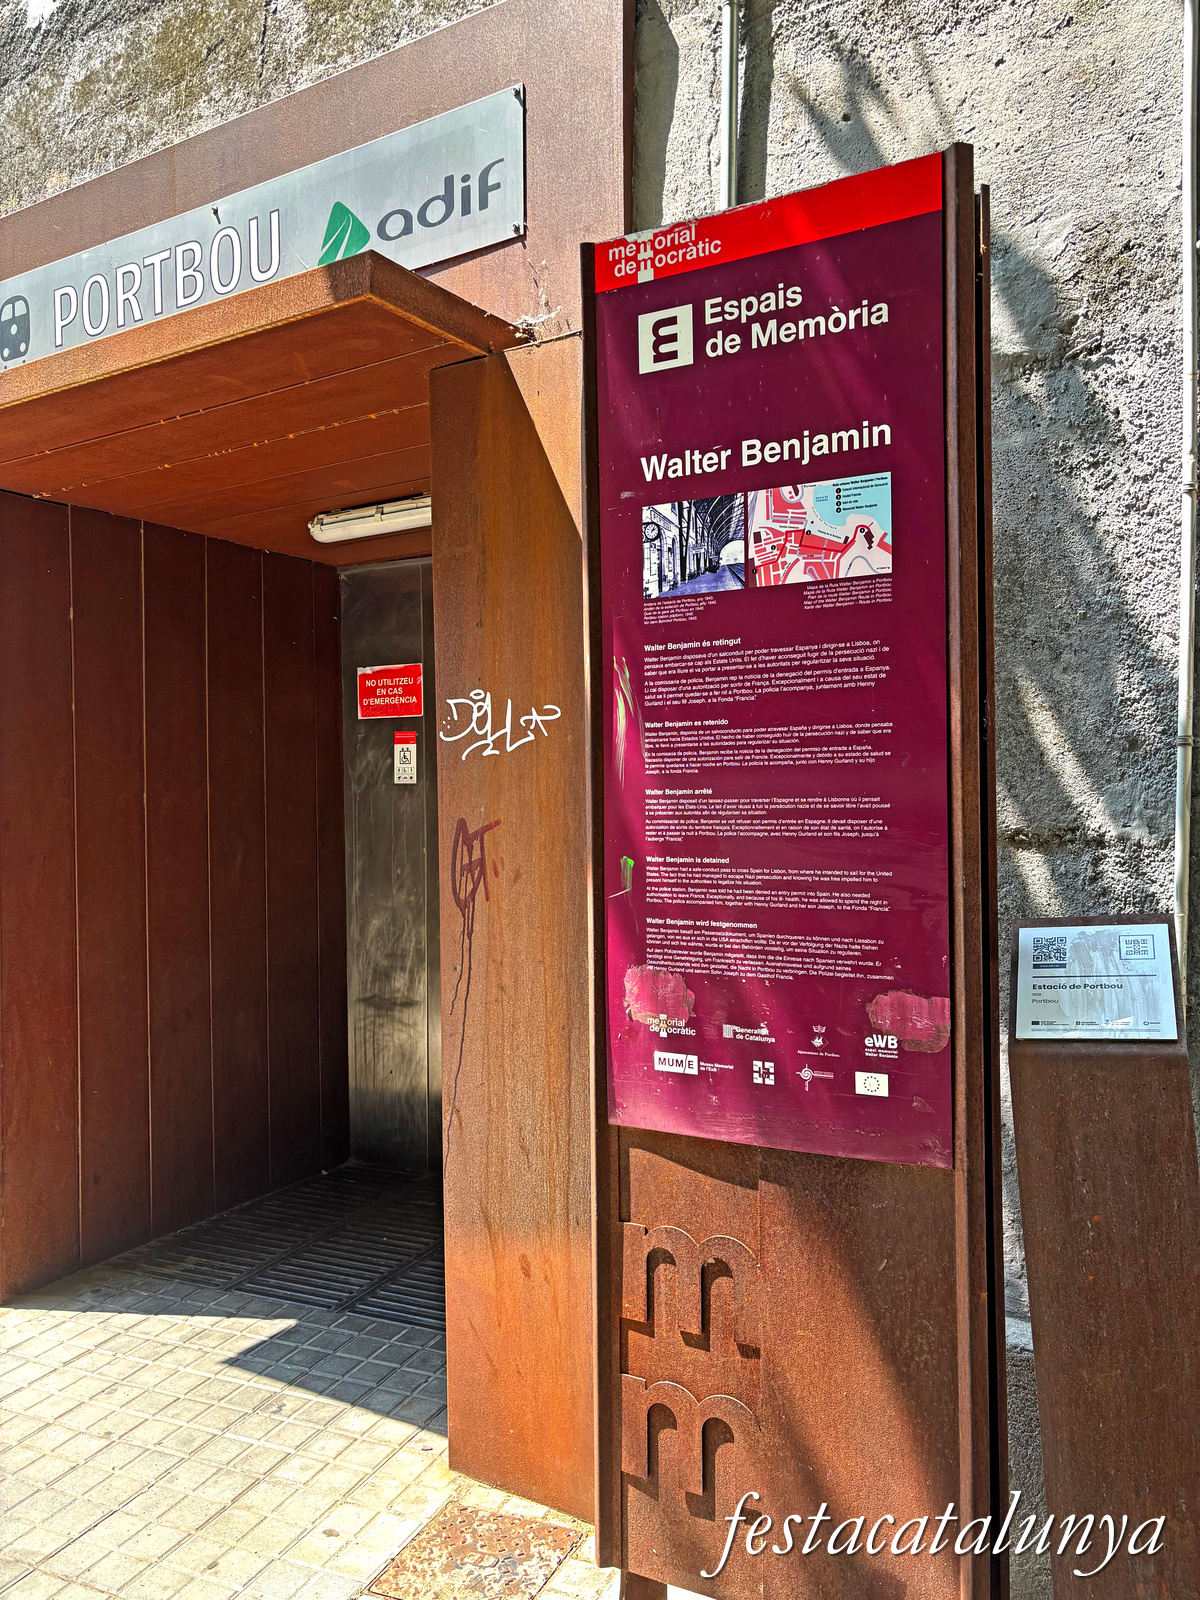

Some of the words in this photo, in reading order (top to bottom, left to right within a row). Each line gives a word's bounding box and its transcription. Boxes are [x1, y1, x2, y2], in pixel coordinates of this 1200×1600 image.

[377, 158, 505, 242] adif
[609, 225, 696, 262] memorial
[614, 240, 722, 278] democràtic
[705, 284, 802, 325] Espais
[706, 327, 741, 358] de
[752, 301, 890, 349] Memòria
[641, 446, 732, 481] Walter
[742, 421, 892, 467] Benjamin
[644, 642, 665, 651] Walter
[667, 638, 700, 651] Benjamin
[702, 637, 710, 647] és
[712, 635, 741, 647] retingut
[378, 677, 413, 686] UTILITZEU
[644, 720, 662, 728] Walter
[664, 719, 692, 728] Benjamin
[702, 717, 728, 725] retenido
[665, 787, 693, 796] Benjamin
[666, 855, 694, 864] Benjamin
[695, 855, 701, 863] is
[646, 916, 664, 924] Walter
[666, 917, 694, 927] Benjamin
[649, 1024, 696, 1036] democràtic
[745, 1034, 776, 1043] Catalunya
[865, 1034, 898, 1049] eWB
